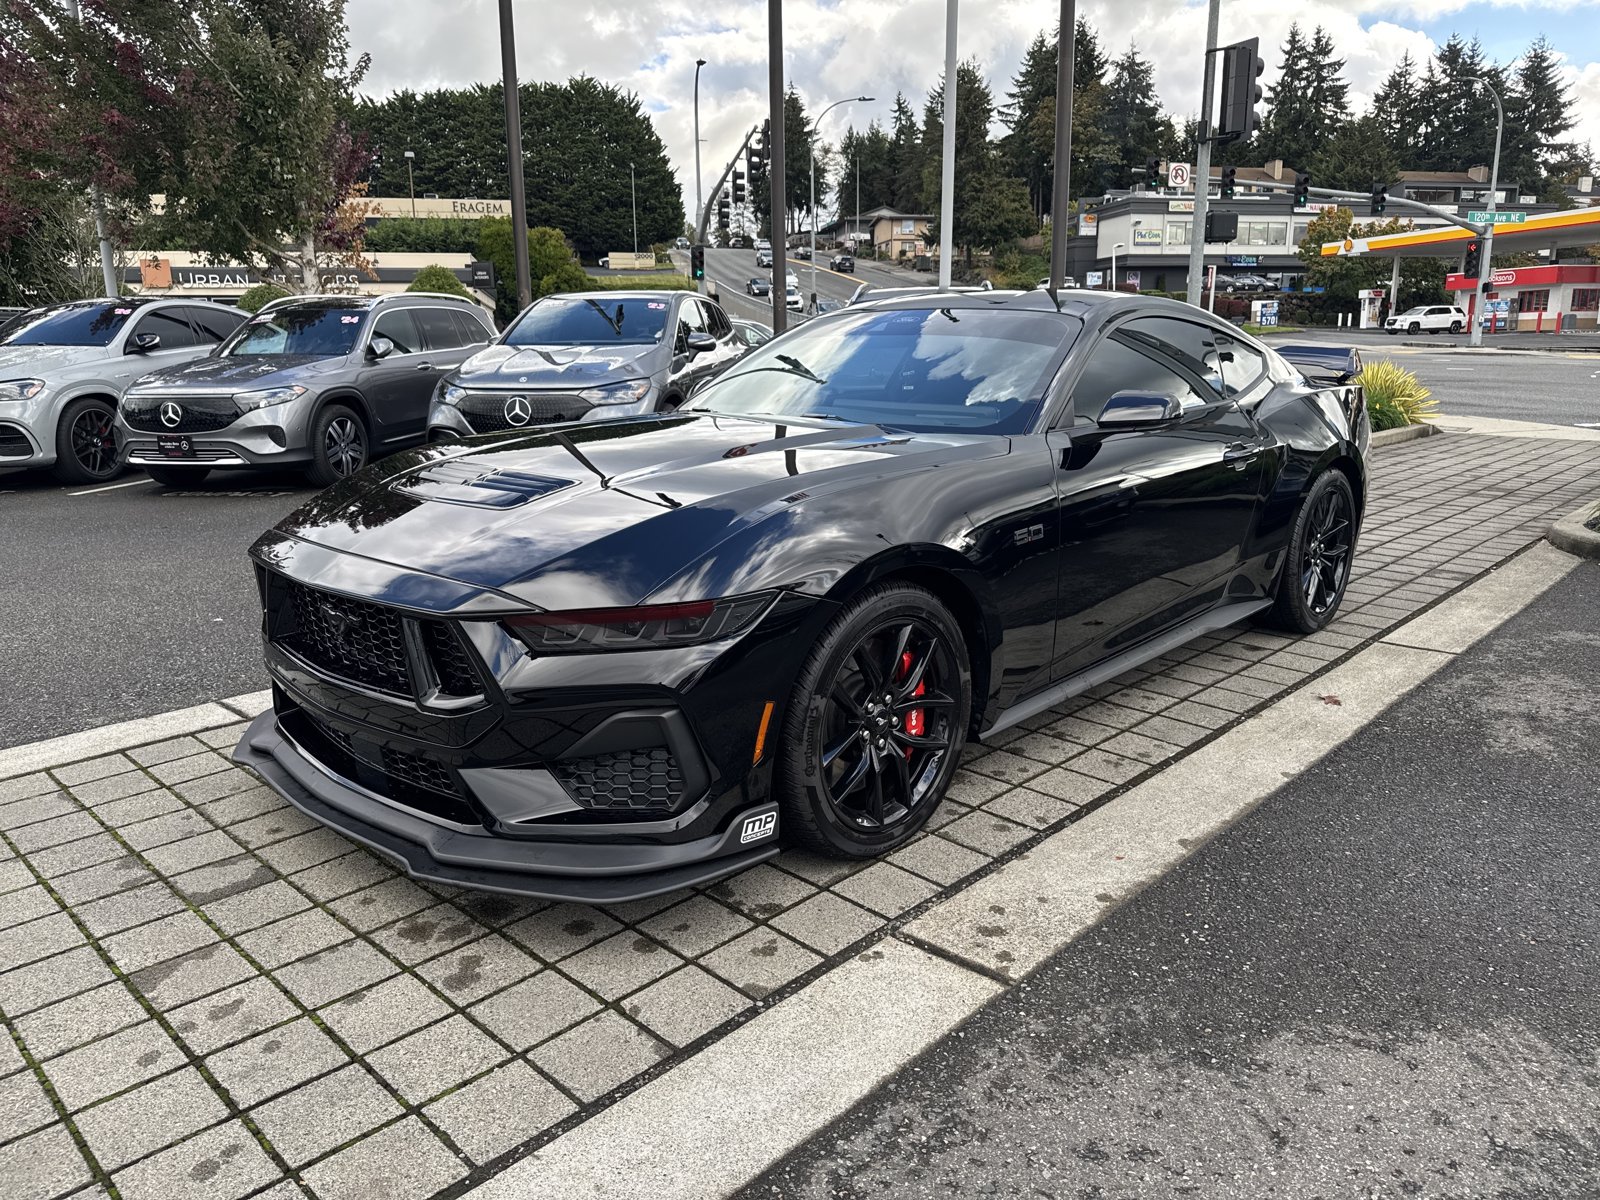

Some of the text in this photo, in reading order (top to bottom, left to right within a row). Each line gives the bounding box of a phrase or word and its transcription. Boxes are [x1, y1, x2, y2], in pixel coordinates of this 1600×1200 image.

[1474, 213, 1520, 222] 120th Ave NE
[179, 272, 249, 289] URBAN
[1488, 274, 1513, 282] acksons
[1014, 523, 1044, 546] 5.0
[743, 813, 775, 835] MP
